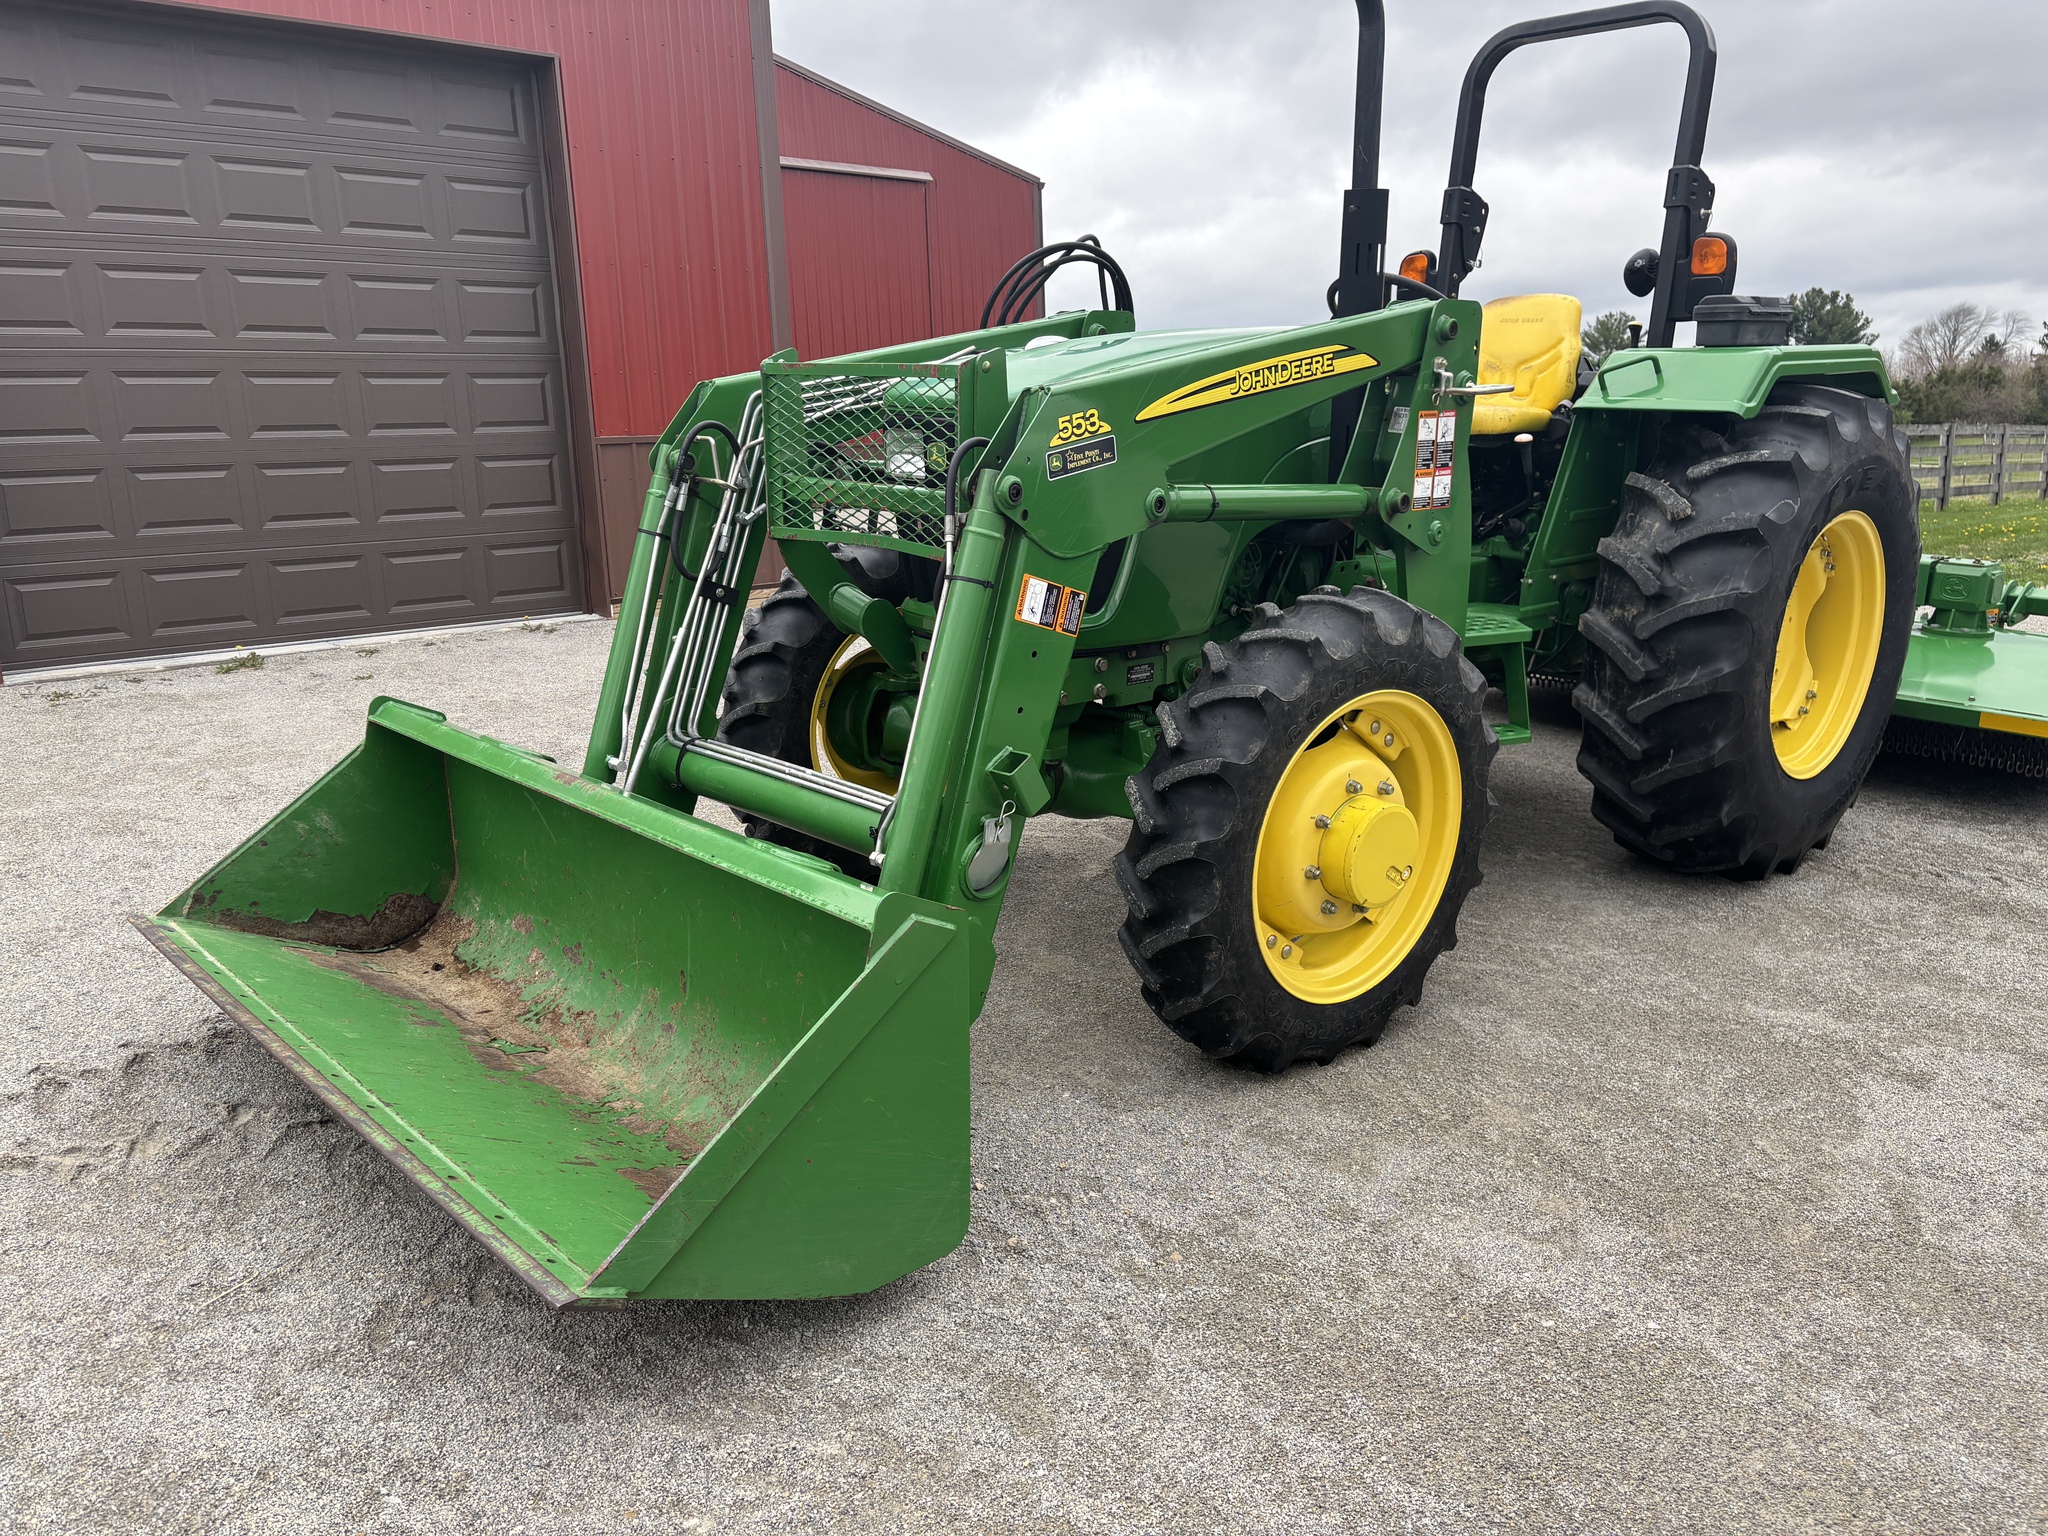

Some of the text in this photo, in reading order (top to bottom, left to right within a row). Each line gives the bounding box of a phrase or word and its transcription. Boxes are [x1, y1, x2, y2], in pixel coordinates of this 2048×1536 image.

[1057, 408, 1101, 441] 553
[1018, 579, 1029, 608] WARNING
[1060, 592, 1070, 620] WARNING
[1284, 659, 1468, 749] GOODYEAR
